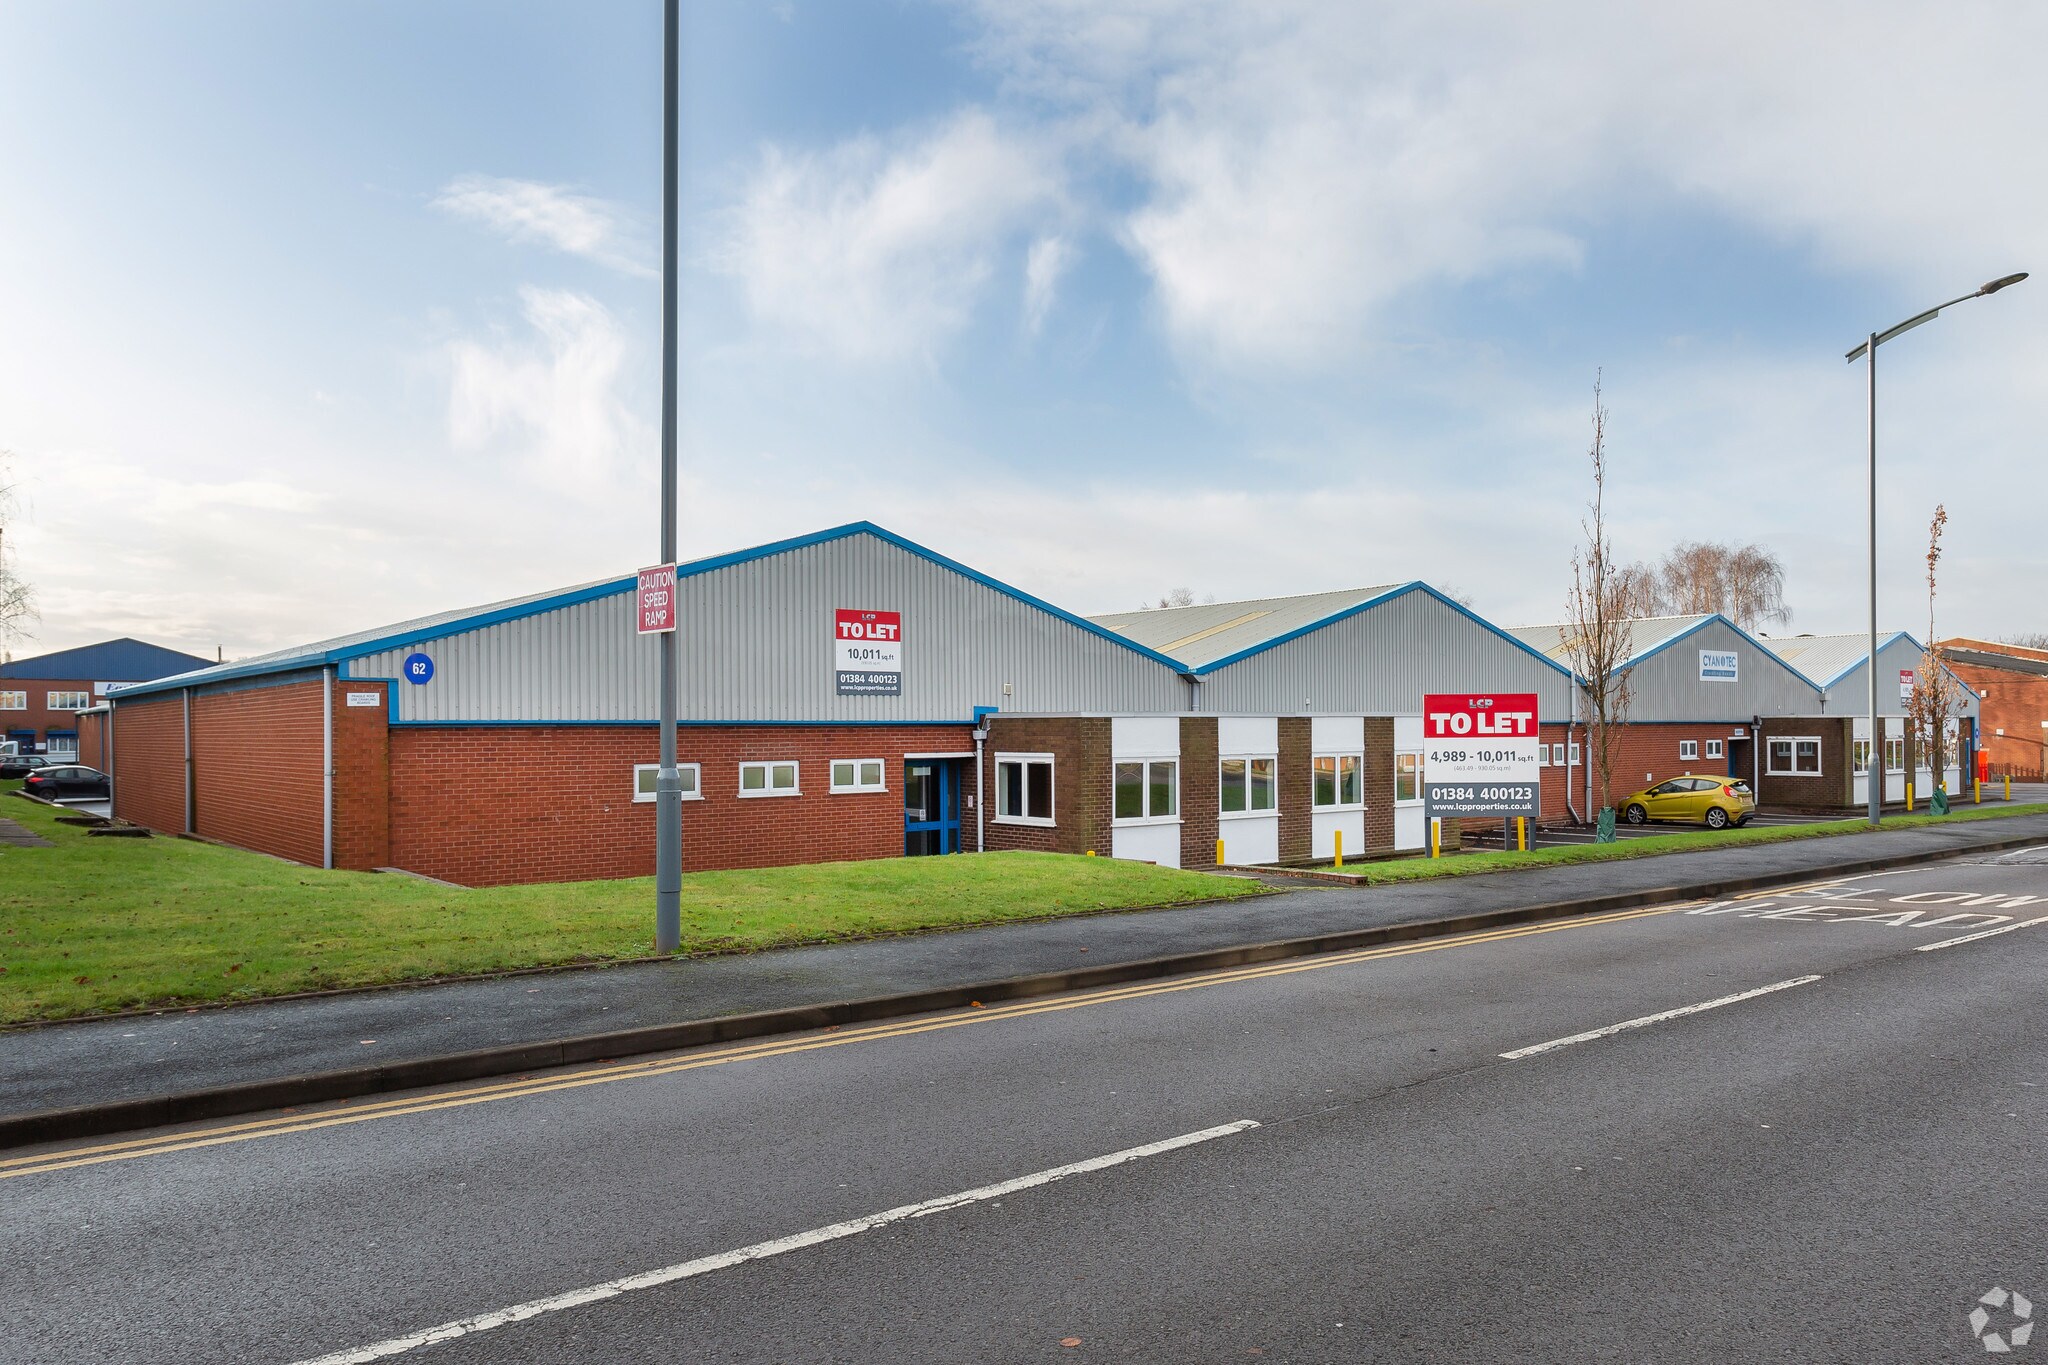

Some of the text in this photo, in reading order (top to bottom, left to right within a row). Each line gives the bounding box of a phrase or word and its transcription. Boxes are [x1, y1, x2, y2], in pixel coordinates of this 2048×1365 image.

[640, 571, 674, 590] CAUTION
[644, 591, 668, 608] SPEED
[645, 610, 667, 626] RAMP
[839, 622, 898, 639] TO LET
[848, 648, 880, 660] 10,011
[413, 663, 425, 674] 62
[840, 674, 897, 684] 01384 400123
[1469, 699, 1494, 709] LCP
[1430, 712, 1533, 735] TO LET
[1430, 751, 1466, 764] 4,989
[1476, 751, 1516, 763] 10,011
[1518, 755, 1534, 763] sq.ft
[1431, 788, 1533, 800] 01384 400123
[1432, 803, 1533, 812] www.lcpproperties.co.uk
